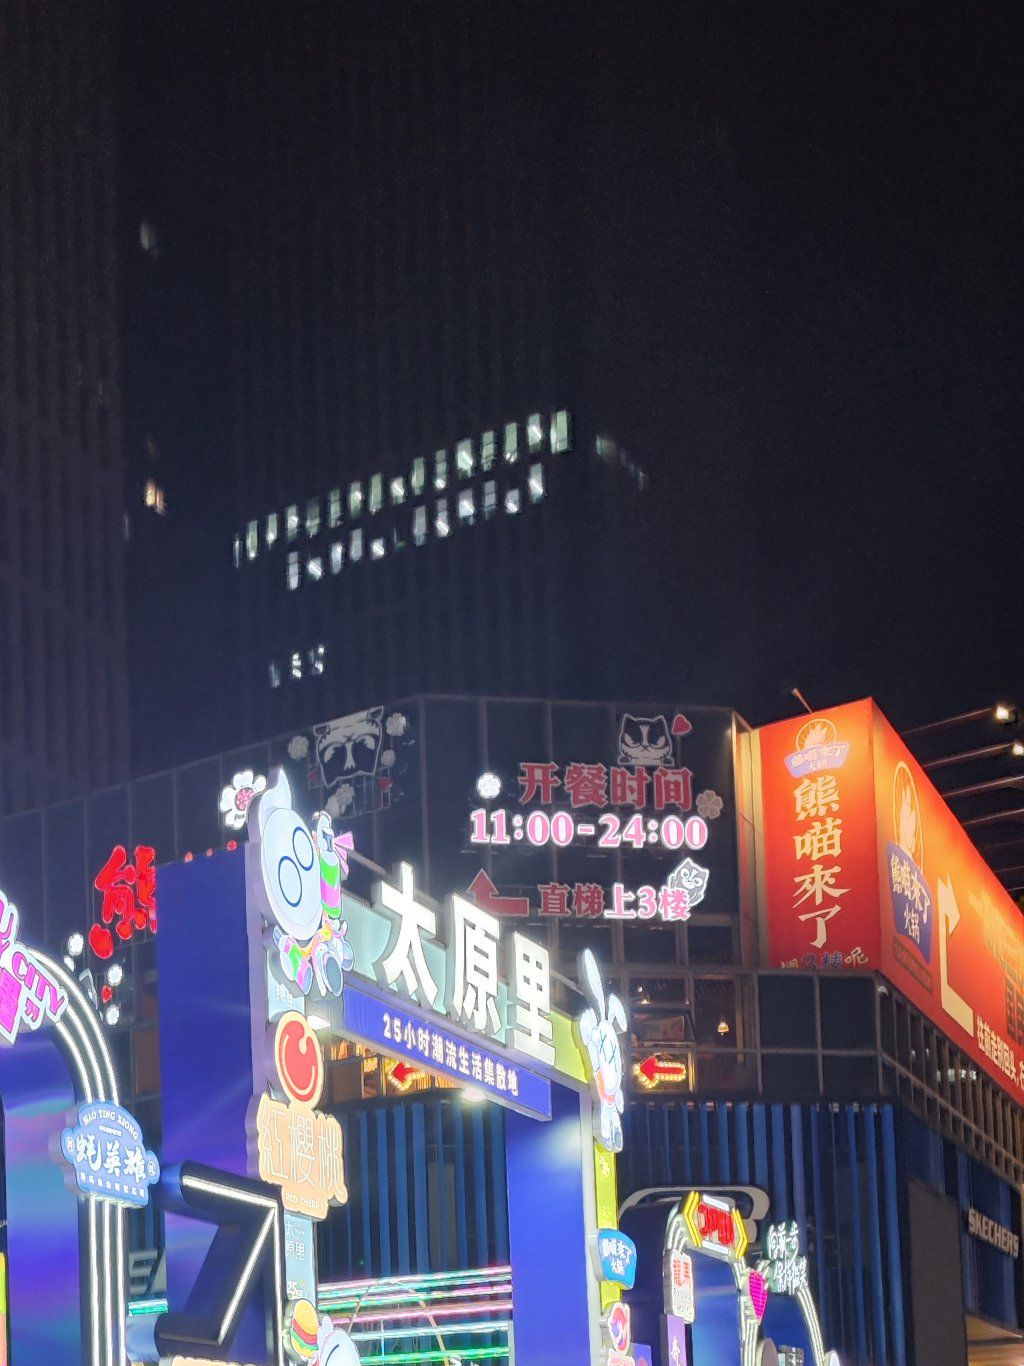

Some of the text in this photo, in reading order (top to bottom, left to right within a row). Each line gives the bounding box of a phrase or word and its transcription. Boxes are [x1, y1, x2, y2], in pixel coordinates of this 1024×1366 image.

[519, 762, 693, 811] 开餐时间
[471, 808, 708, 850] 11:00-24:00
[538, 882, 692, 922] 直梯上3楼
[12, 951, 64, 1016] CITY
[381, 862, 557, 1068] 太原里
[383, 1012, 520, 1097] 25小时潮流生活集散地
[285, 1193, 299, 1205] RED
[968, 1208, 1020, 1258] SKECHERS
